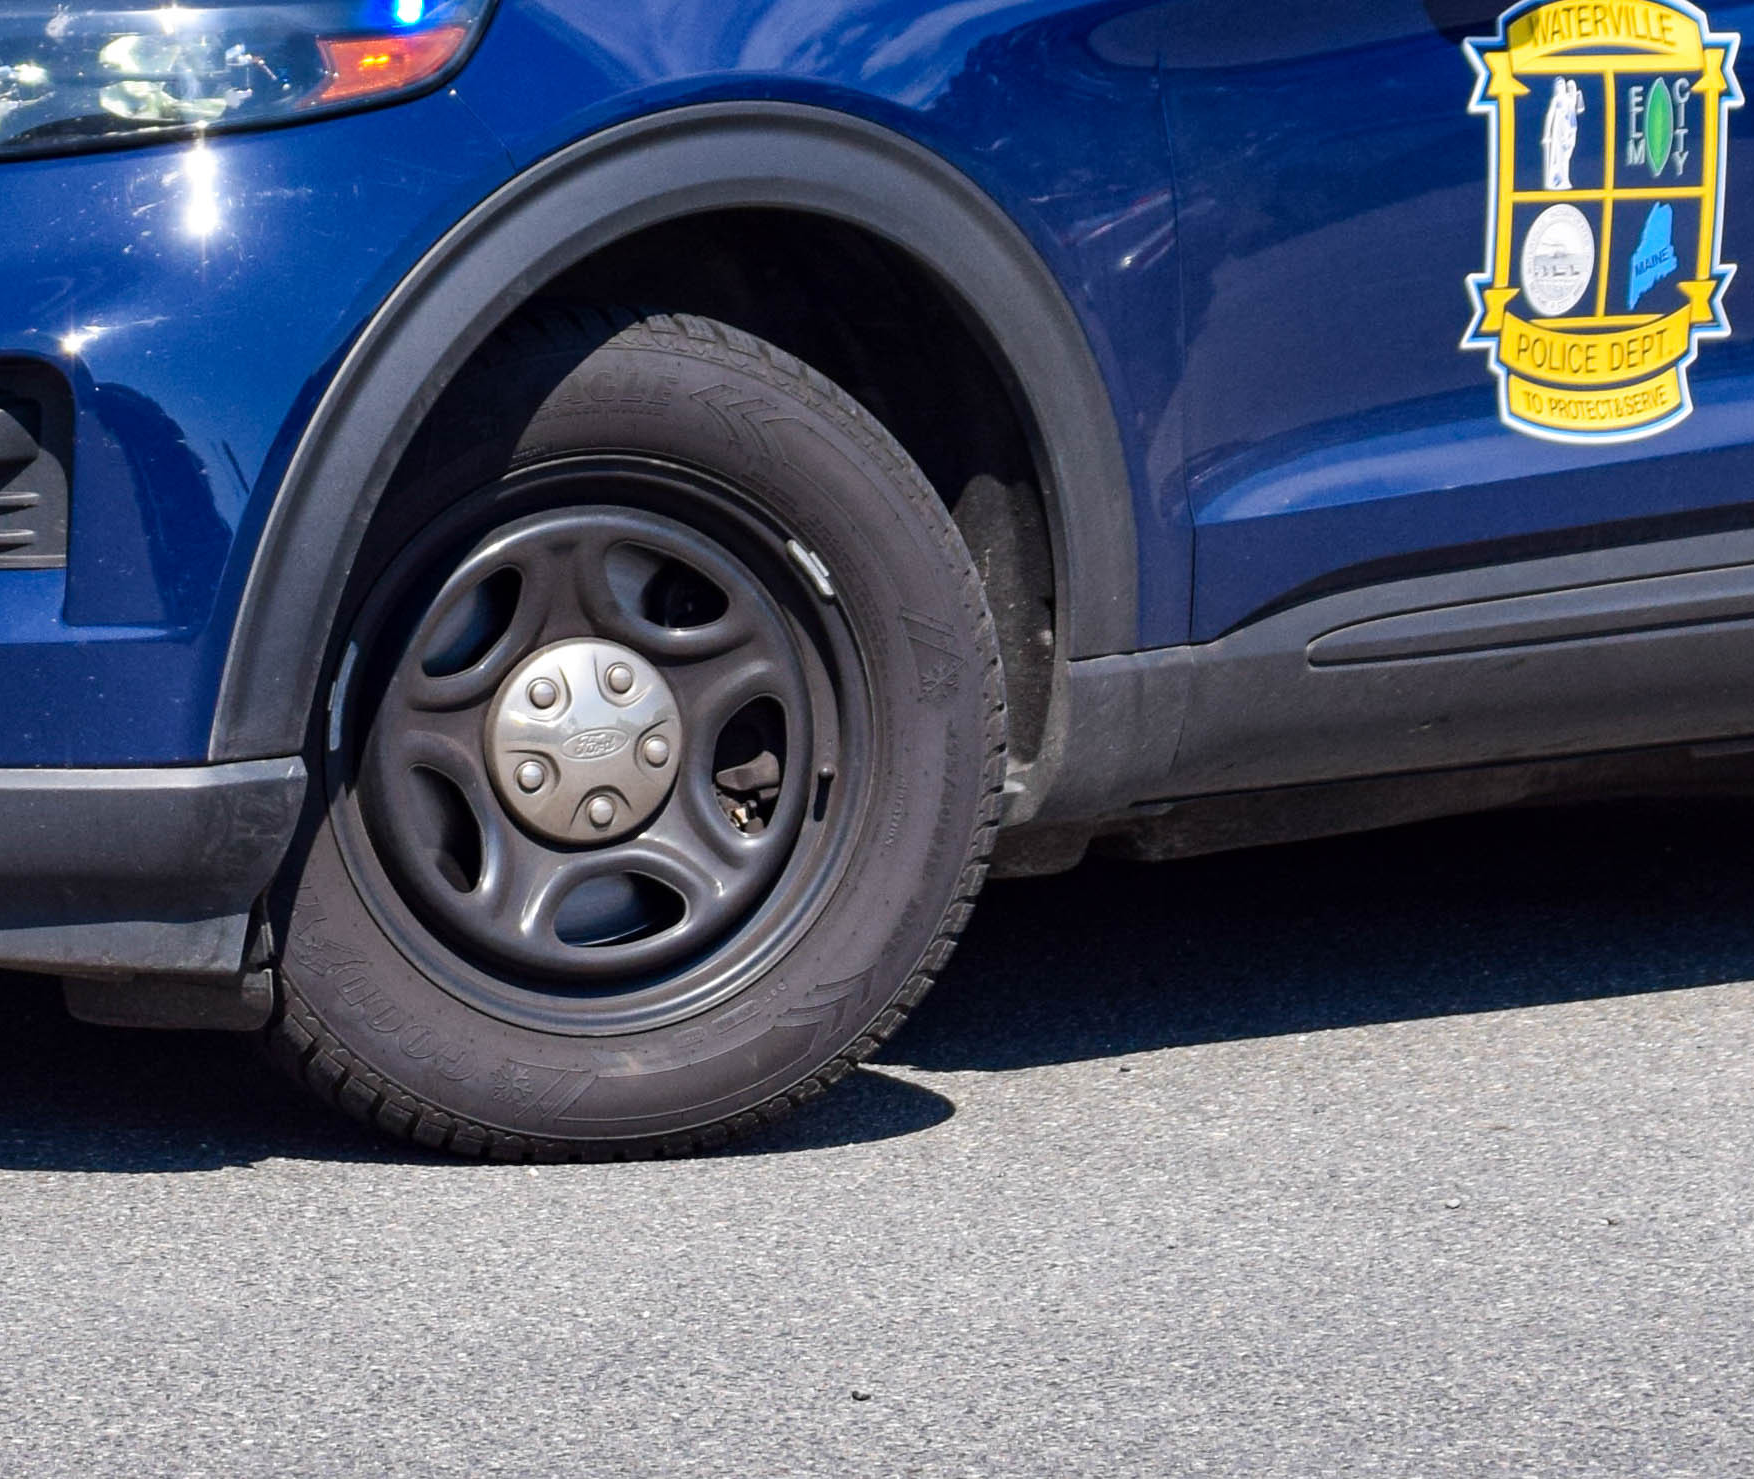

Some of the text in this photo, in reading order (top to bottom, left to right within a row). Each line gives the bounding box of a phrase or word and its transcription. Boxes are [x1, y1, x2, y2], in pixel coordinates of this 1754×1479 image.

[1530, 4, 1677, 48] WATERVILLE
[1635, 248, 1670, 278] MAINE
[1517, 333, 1598, 374] POLICE
[1523, 390, 1544, 415] TO
